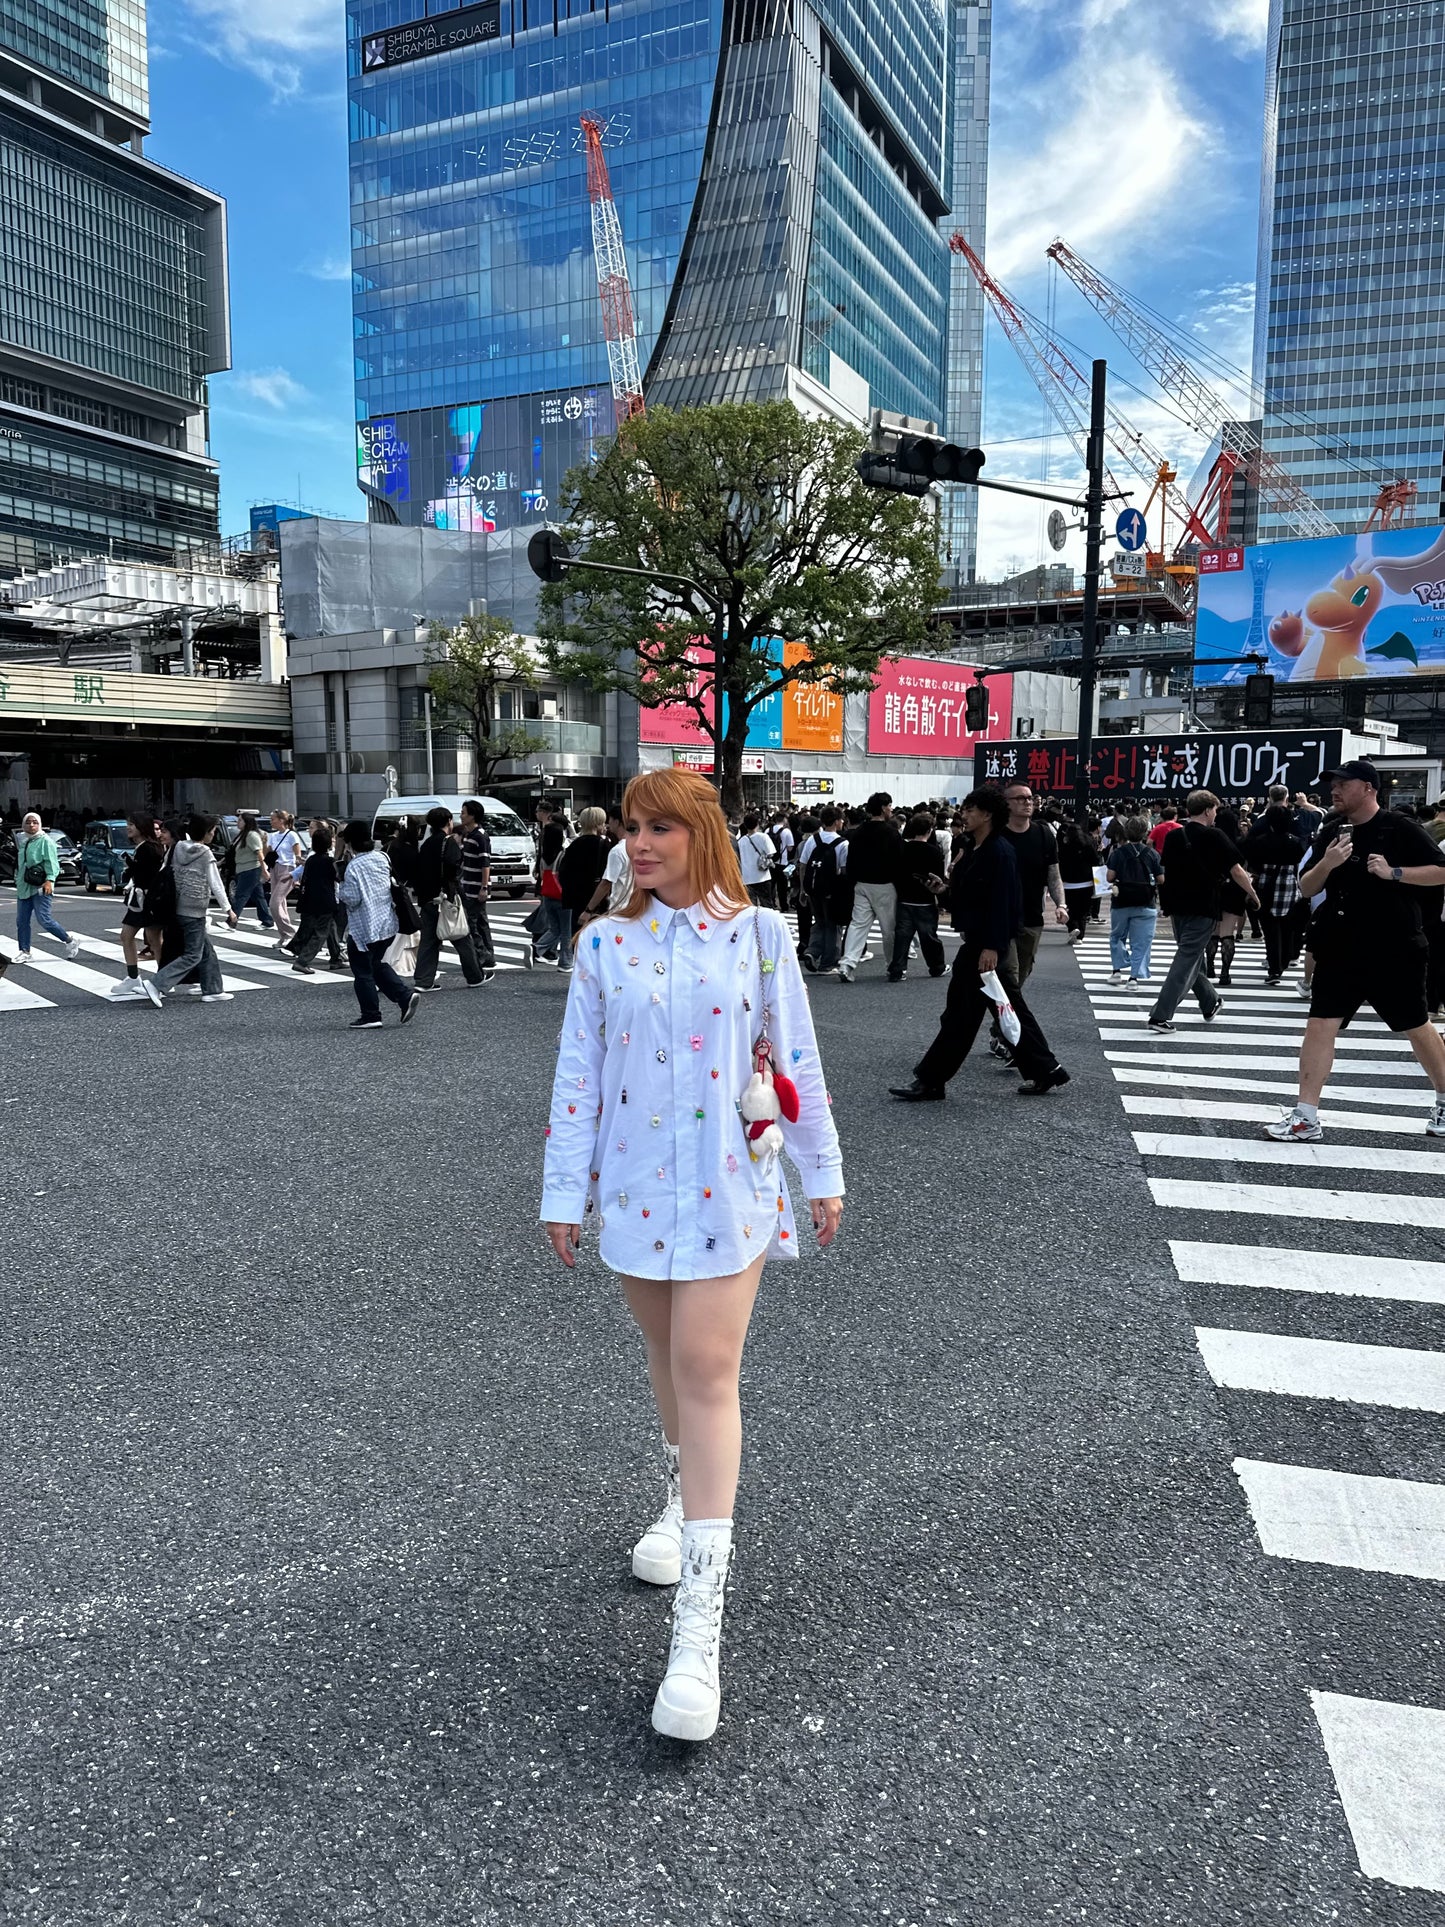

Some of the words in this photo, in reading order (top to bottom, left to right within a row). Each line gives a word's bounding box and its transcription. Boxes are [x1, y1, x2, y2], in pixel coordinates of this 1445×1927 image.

[387, 23, 436, 48] SHIBUYA
[387, 34, 447, 61] SCRAMBLE
[449, 19, 496, 44] SQUARE
[884, 691, 999, 739] 龍角散ダイト
[985, 749, 1018, 778] 迷惑
